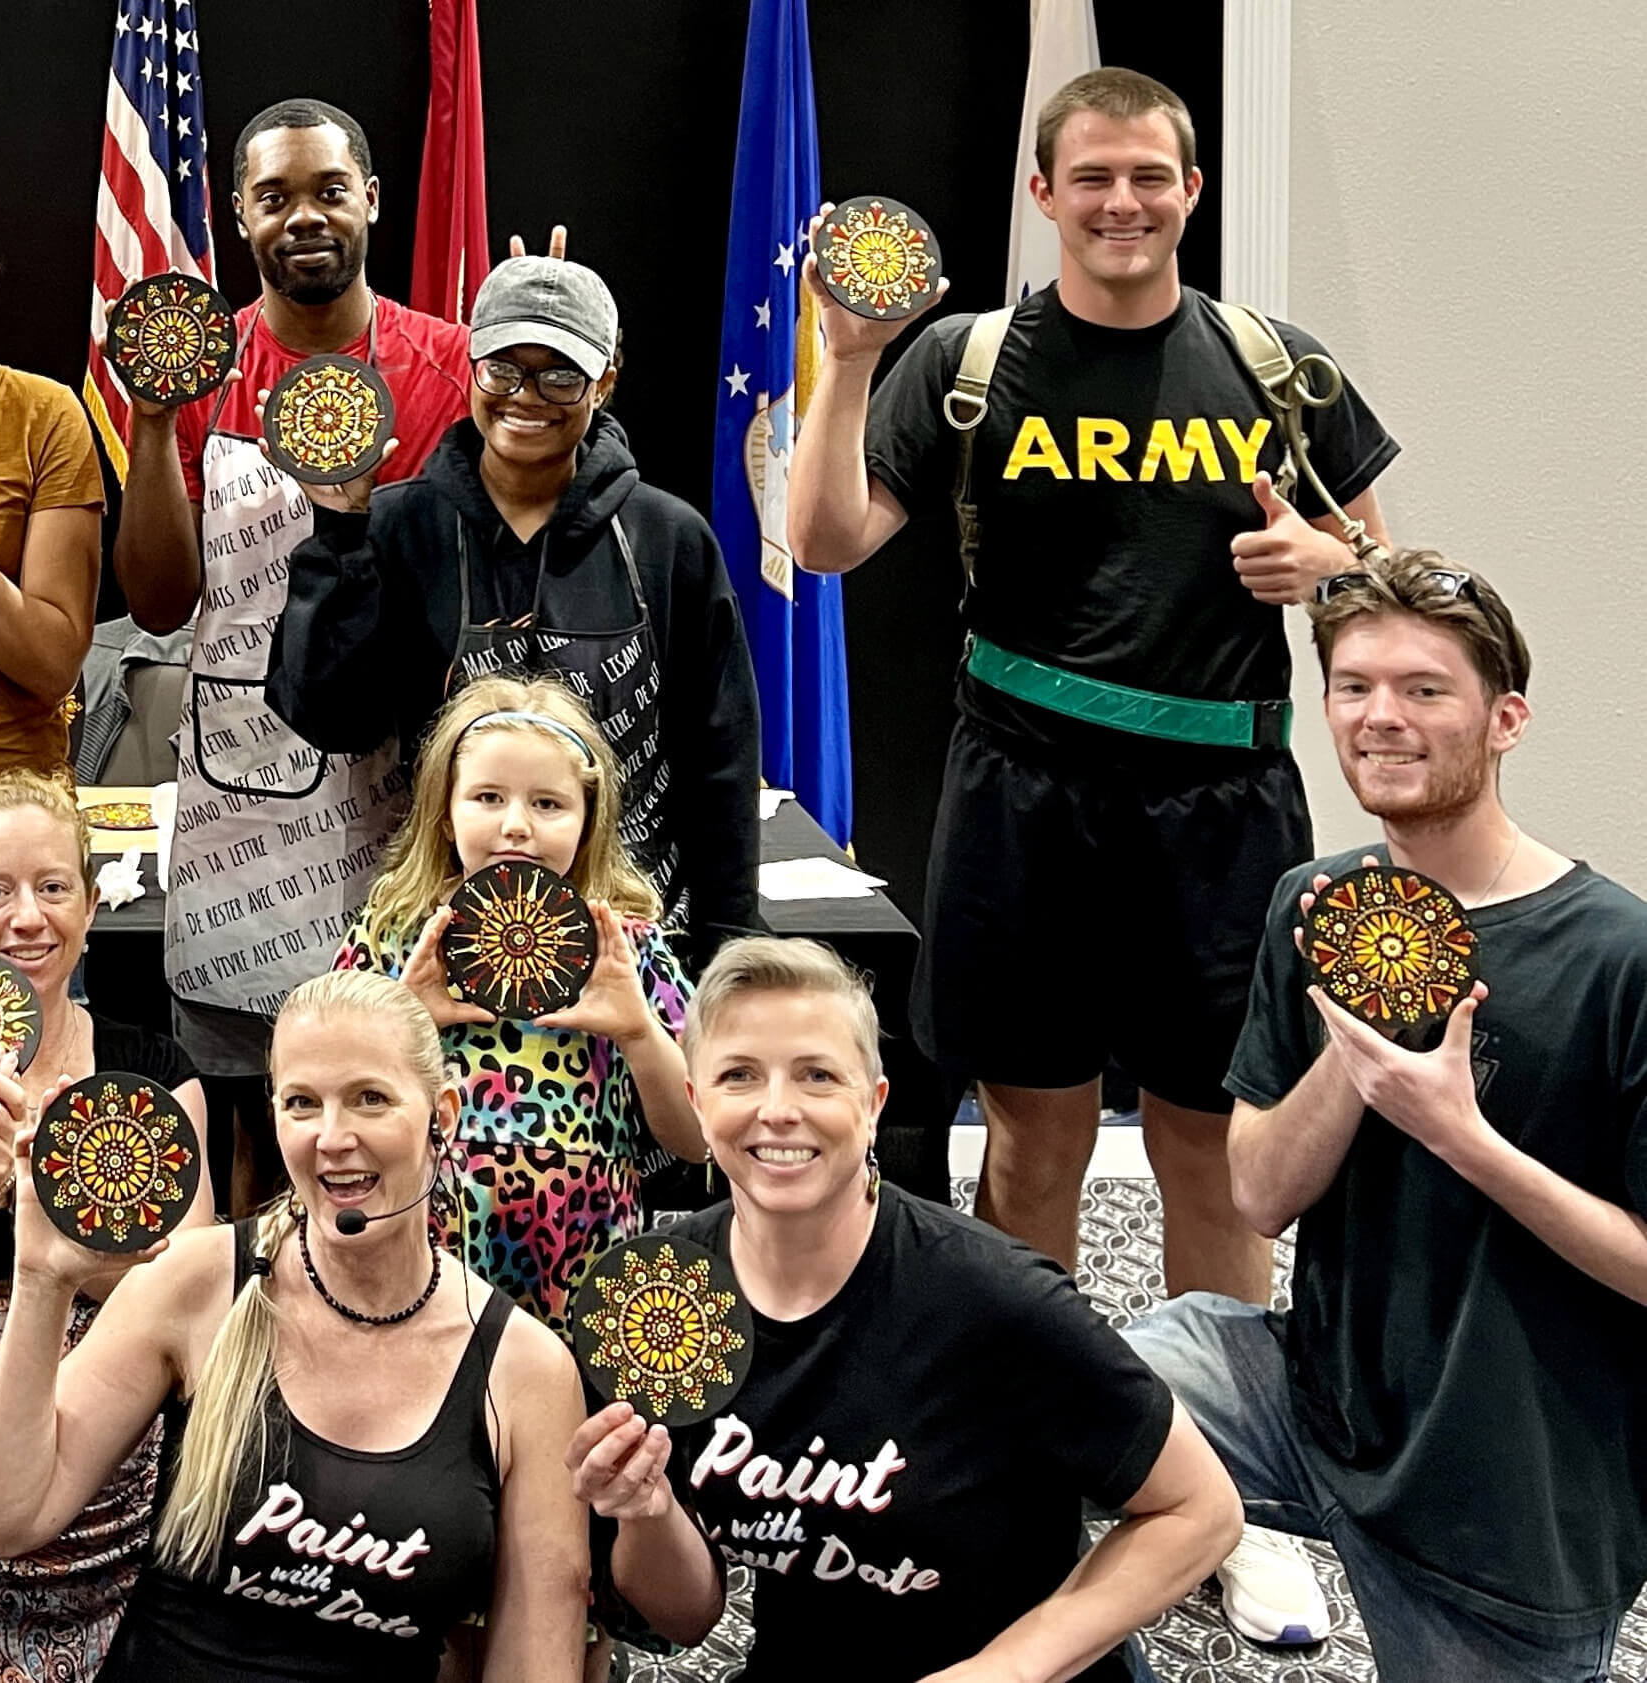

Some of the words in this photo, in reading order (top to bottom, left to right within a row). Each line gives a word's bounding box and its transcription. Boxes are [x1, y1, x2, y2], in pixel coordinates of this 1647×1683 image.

[238, 473, 256, 497] DE
[240, 525, 259, 549] DE
[260, 509, 287, 539] RIRE
[205, 585, 235, 614] MAIS
[240, 574, 260, 599] EN
[200, 635, 241, 667] TOUTE
[241, 626, 263, 650] LA
[461, 647, 503, 681] MAIS
[505, 635, 529, 664] EN
[569, 671, 594, 697] DE
[600, 635, 643, 683] LISANT
[634, 684, 651, 711] DE
[202, 728, 241, 759] LETTRE
[243, 713, 279, 743] J'AI
[256, 762, 284, 788] TOI
[220, 793, 242, 815] TU
[203, 851, 227, 875] TA
[227, 834, 269, 868] LETTRE
[277, 815, 315, 847] TOUTE
[315, 808, 335, 833] LA
[334, 797, 363, 826] VIE
[185, 911, 206, 937] DE
[205, 897, 246, 930] RESTER
[246, 884, 276, 915] AVEC
[275, 874, 304, 902] TOI
[303, 861, 337, 894] J'AI
[336, 842, 378, 882] ENVIE
[195, 963, 214, 987] DE
[209, 949, 251, 982] VIVRE
[252, 936, 284, 968] AVEC
[279, 928, 307, 956] TOI
[309, 914, 342, 948] J'AI
[689, 1412, 907, 1514] Paint
[233, 1480, 432, 1581] Paint
[730, 1506, 808, 1544] with
[268, 1559, 335, 1593] with
[812, 1533, 942, 1597] Date
[223, 1565, 318, 1609] Your
[314, 1588, 420, 1639] Date
